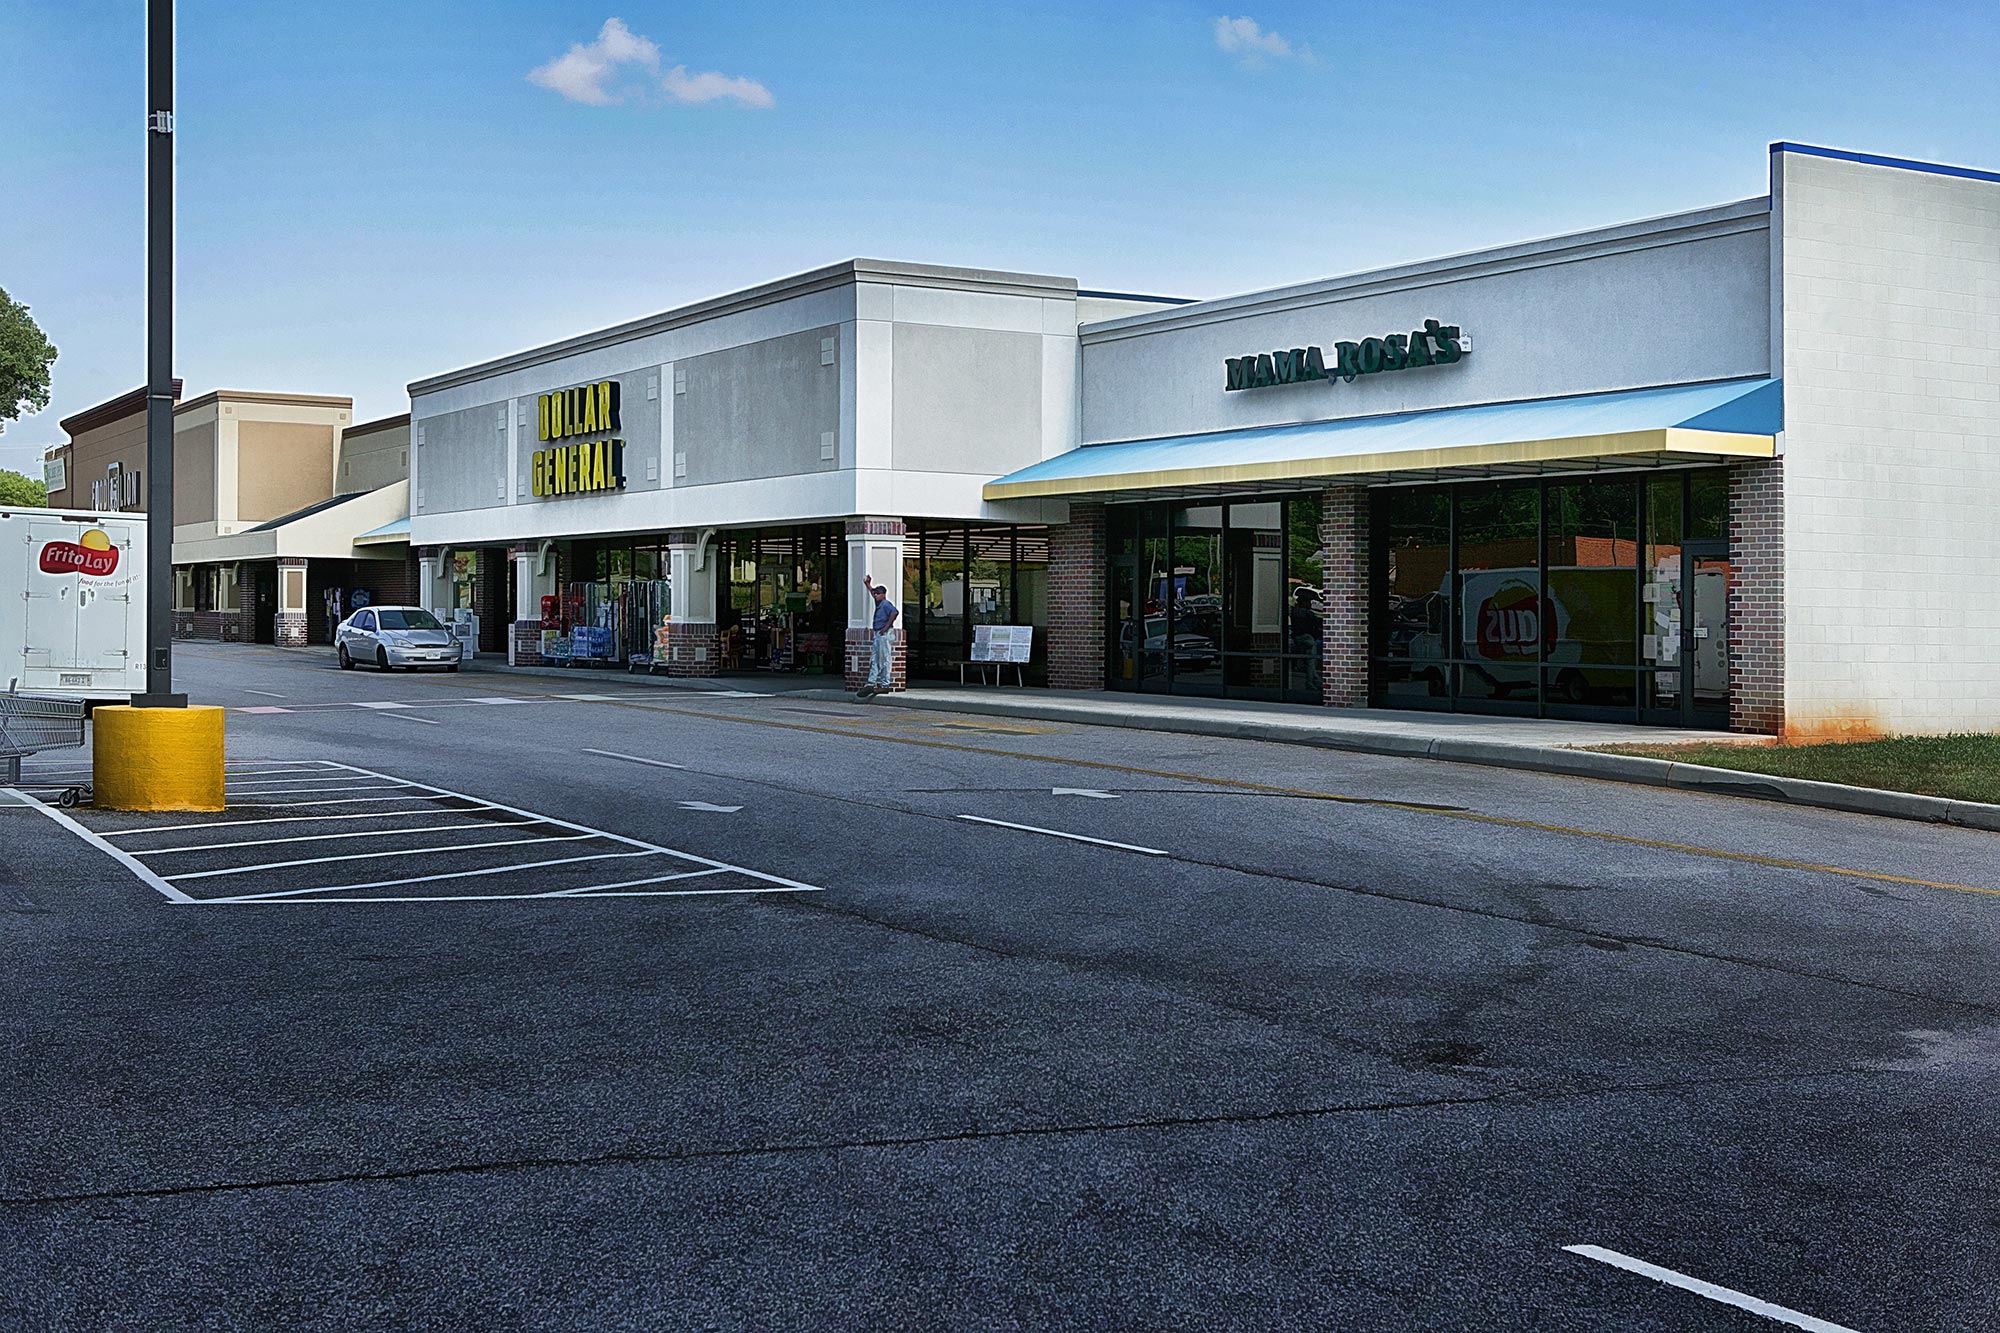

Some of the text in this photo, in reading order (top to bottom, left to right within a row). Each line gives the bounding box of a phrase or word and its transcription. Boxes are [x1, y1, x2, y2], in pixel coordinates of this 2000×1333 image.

[1225, 319, 1462, 391] MAMA ROSA'S
[538, 381, 614, 441] DOLLAR
[91, 471, 138, 511] FOOD LION
[532, 439, 618, 497] GENERAL
[79, 577, 94, 586] food
